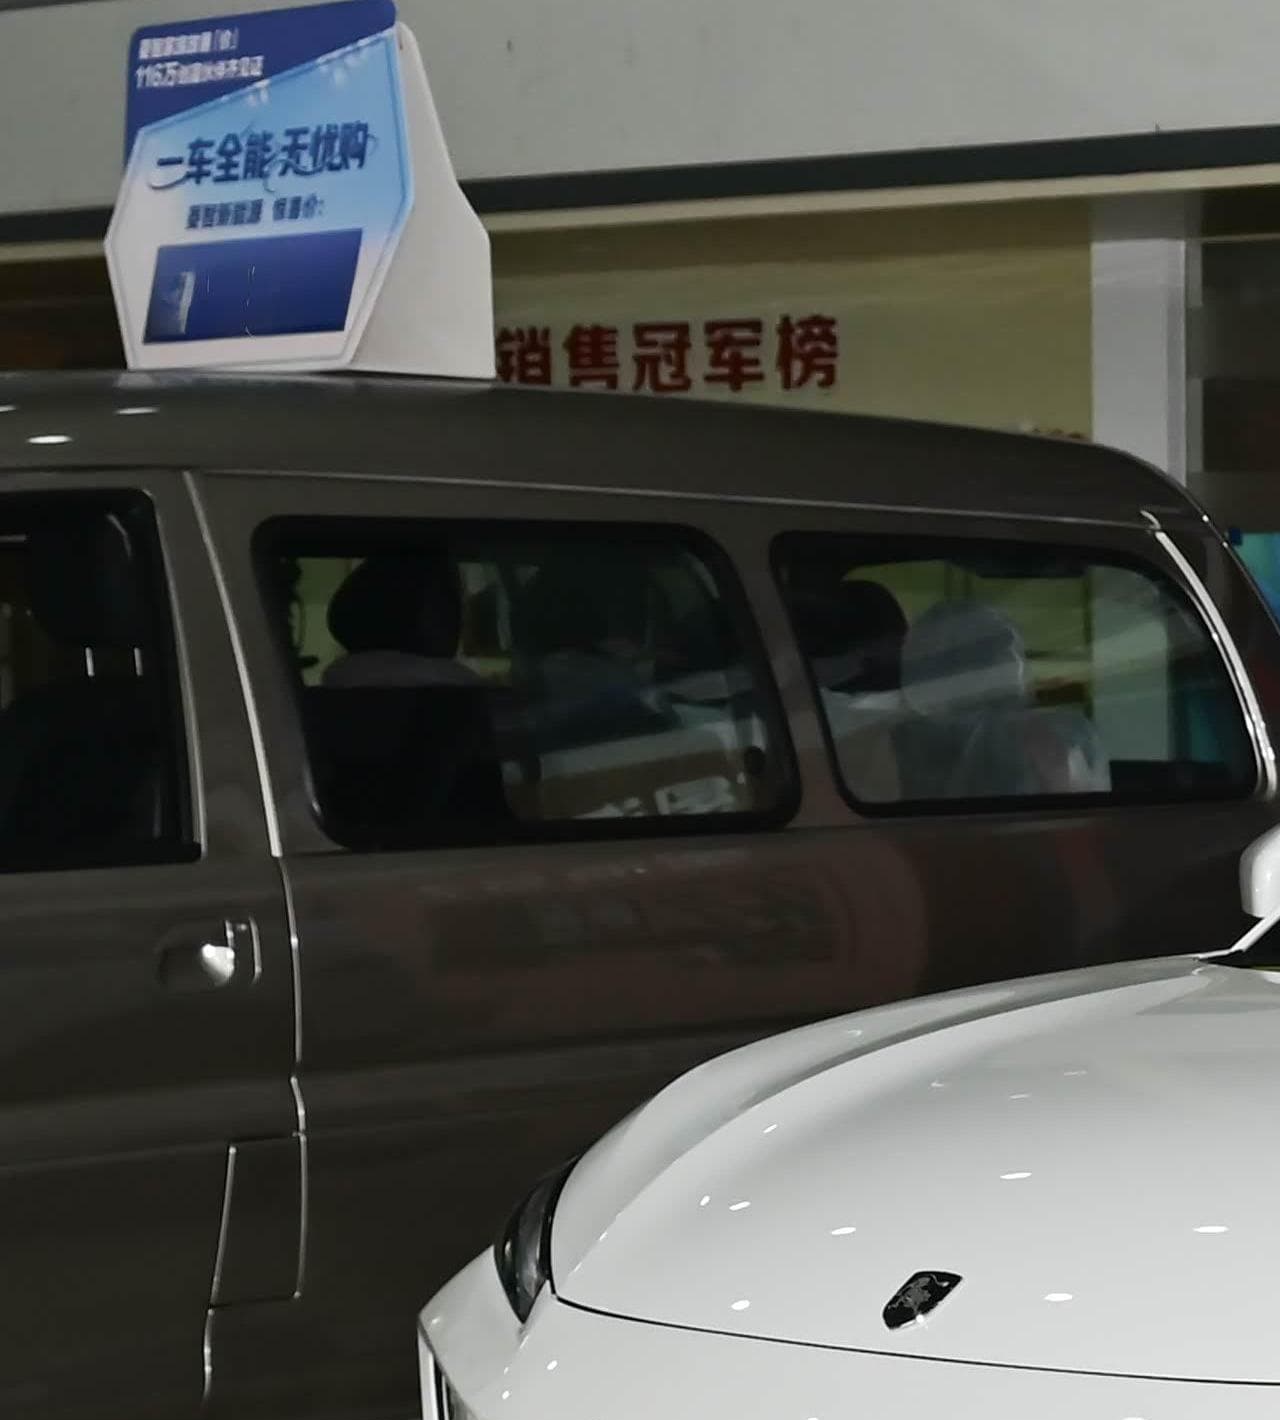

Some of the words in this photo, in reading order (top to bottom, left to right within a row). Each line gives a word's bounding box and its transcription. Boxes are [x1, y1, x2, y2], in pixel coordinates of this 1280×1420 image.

[495, 313, 839, 392] 销售冠军榜
